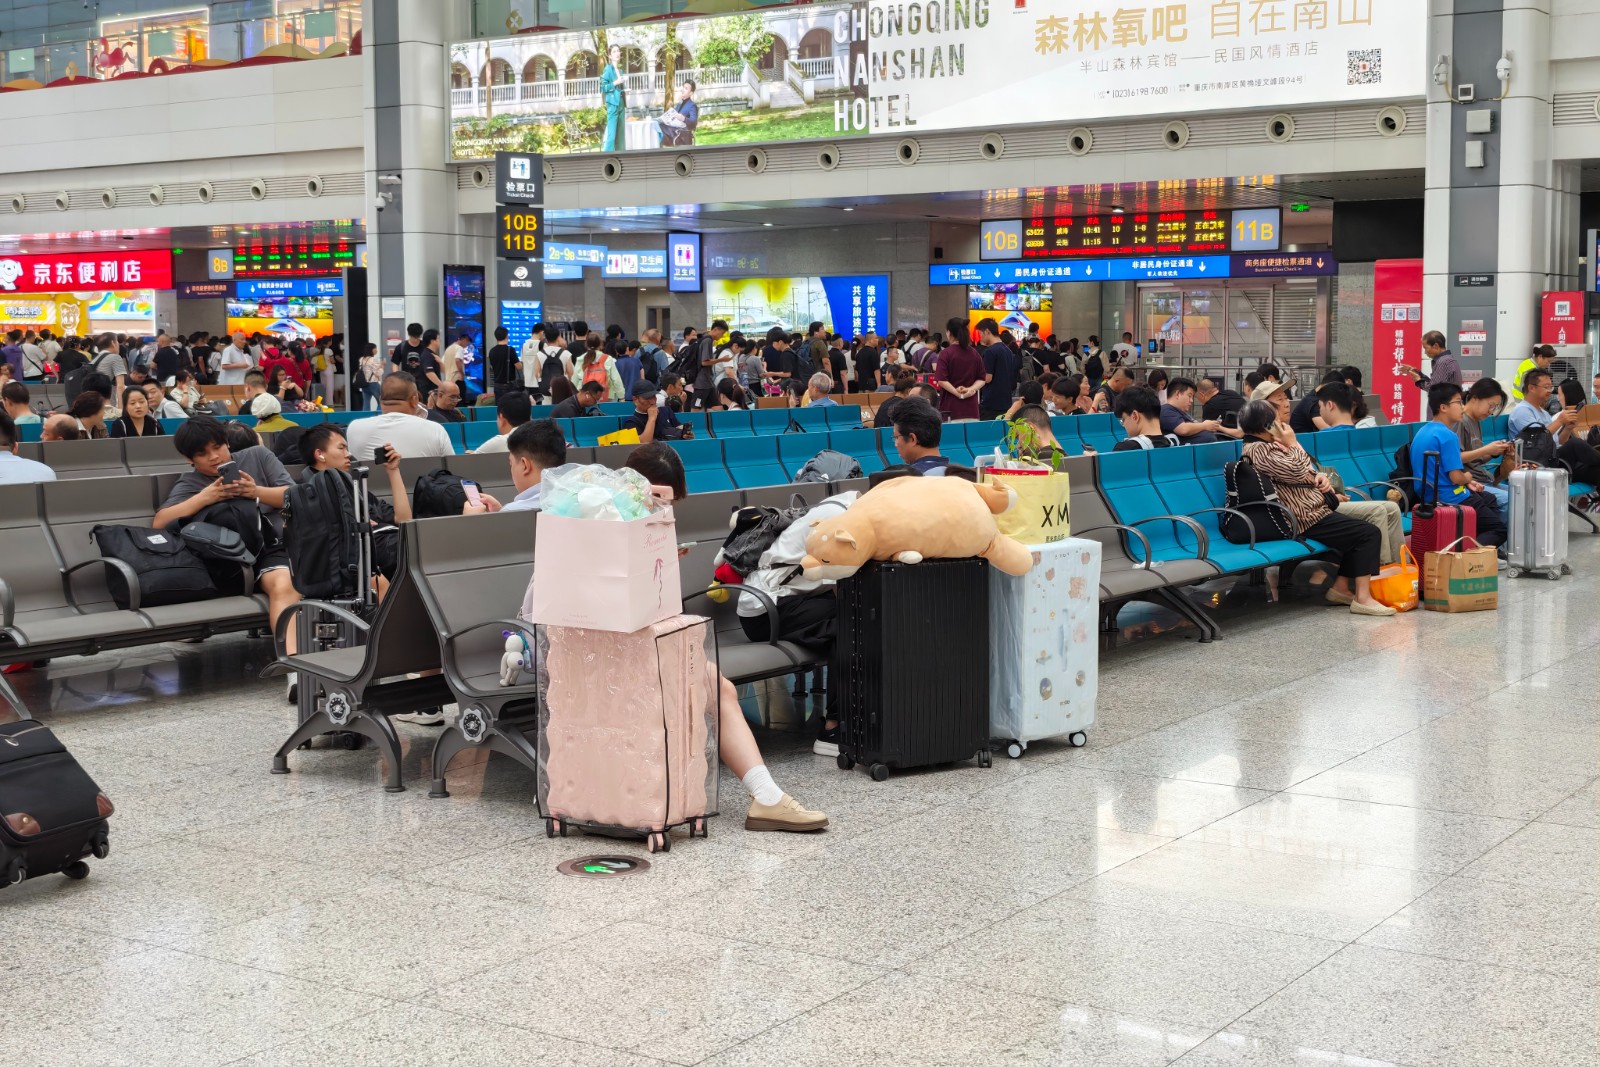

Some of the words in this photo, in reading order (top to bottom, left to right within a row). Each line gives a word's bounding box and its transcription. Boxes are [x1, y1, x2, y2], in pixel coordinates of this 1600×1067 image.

[834, 0, 990, 44] CHONGQING
[1034, 3, 1188, 56] 森林氧吧
[1210, 0, 1374, 40] 自在南山
[834, 43, 965, 88] NANSHAN
[1150, 86, 1168, 95] 7600
[834, 93, 917, 132] HOTEL
[456, 138, 493, 147] CHONGQING
[493, 136, 524, 145] NANSHAN
[506, 181, 536, 193] 检票口
[503, 214, 538, 231] 10B
[1083, 226, 1101, 234] 10:41
[1112, 225, 1121, 233] 10
[1236, 219, 1274, 241] 11B
[503, 234, 536, 251] 11B
[983, 229, 1019, 252] 10B
[1083, 238, 1101, 246] 11:15
[1112, 237, 1120, 245] 11
[213, 256, 229, 274] 8B
[639, 255, 664, 266] 卫生间
[1131, 259, 1194, 269] 非居民身份证通道
[1244, 257, 1313, 267] 商务座便捷检票通道
[33, 260, 142, 285] 京东便利店
[673, 267, 696, 277] 卫生间
[1014, 267, 1071, 277] 居民身份证通道
[852, 285, 861, 338] 共享旅途生
